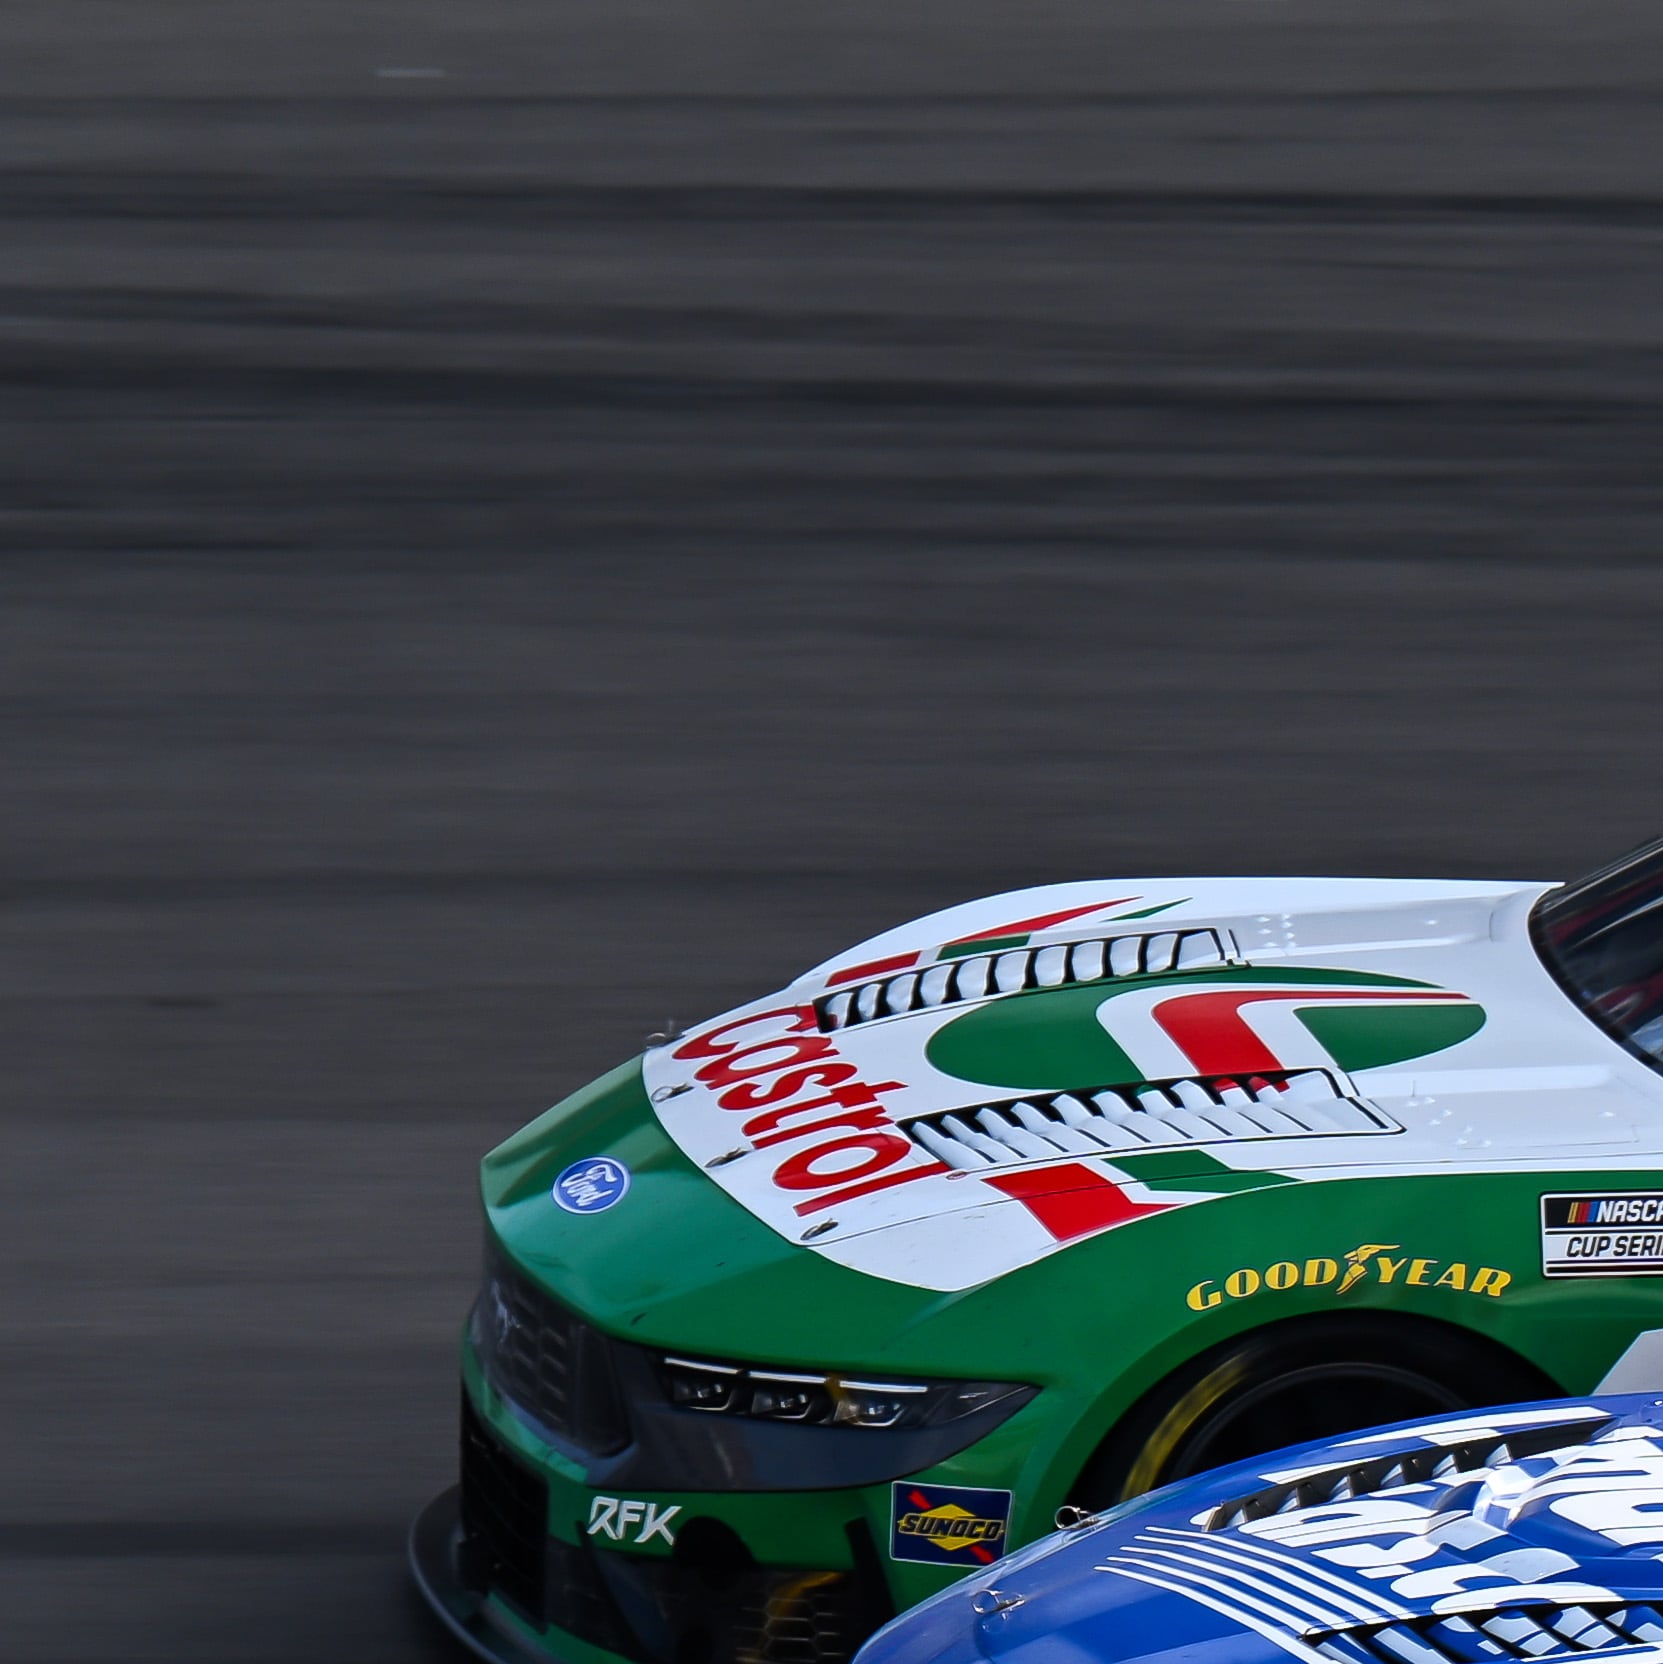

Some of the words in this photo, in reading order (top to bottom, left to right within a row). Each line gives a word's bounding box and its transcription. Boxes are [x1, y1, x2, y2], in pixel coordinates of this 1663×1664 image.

[672, 1004, 950, 1217] Castrol
[561, 1164, 617, 1207] Ford
[1567, 1236, 1610, 1258] CUP
[587, 1495, 682, 1545] RFK
[899, 1513, 1000, 1541] SUNOCO
